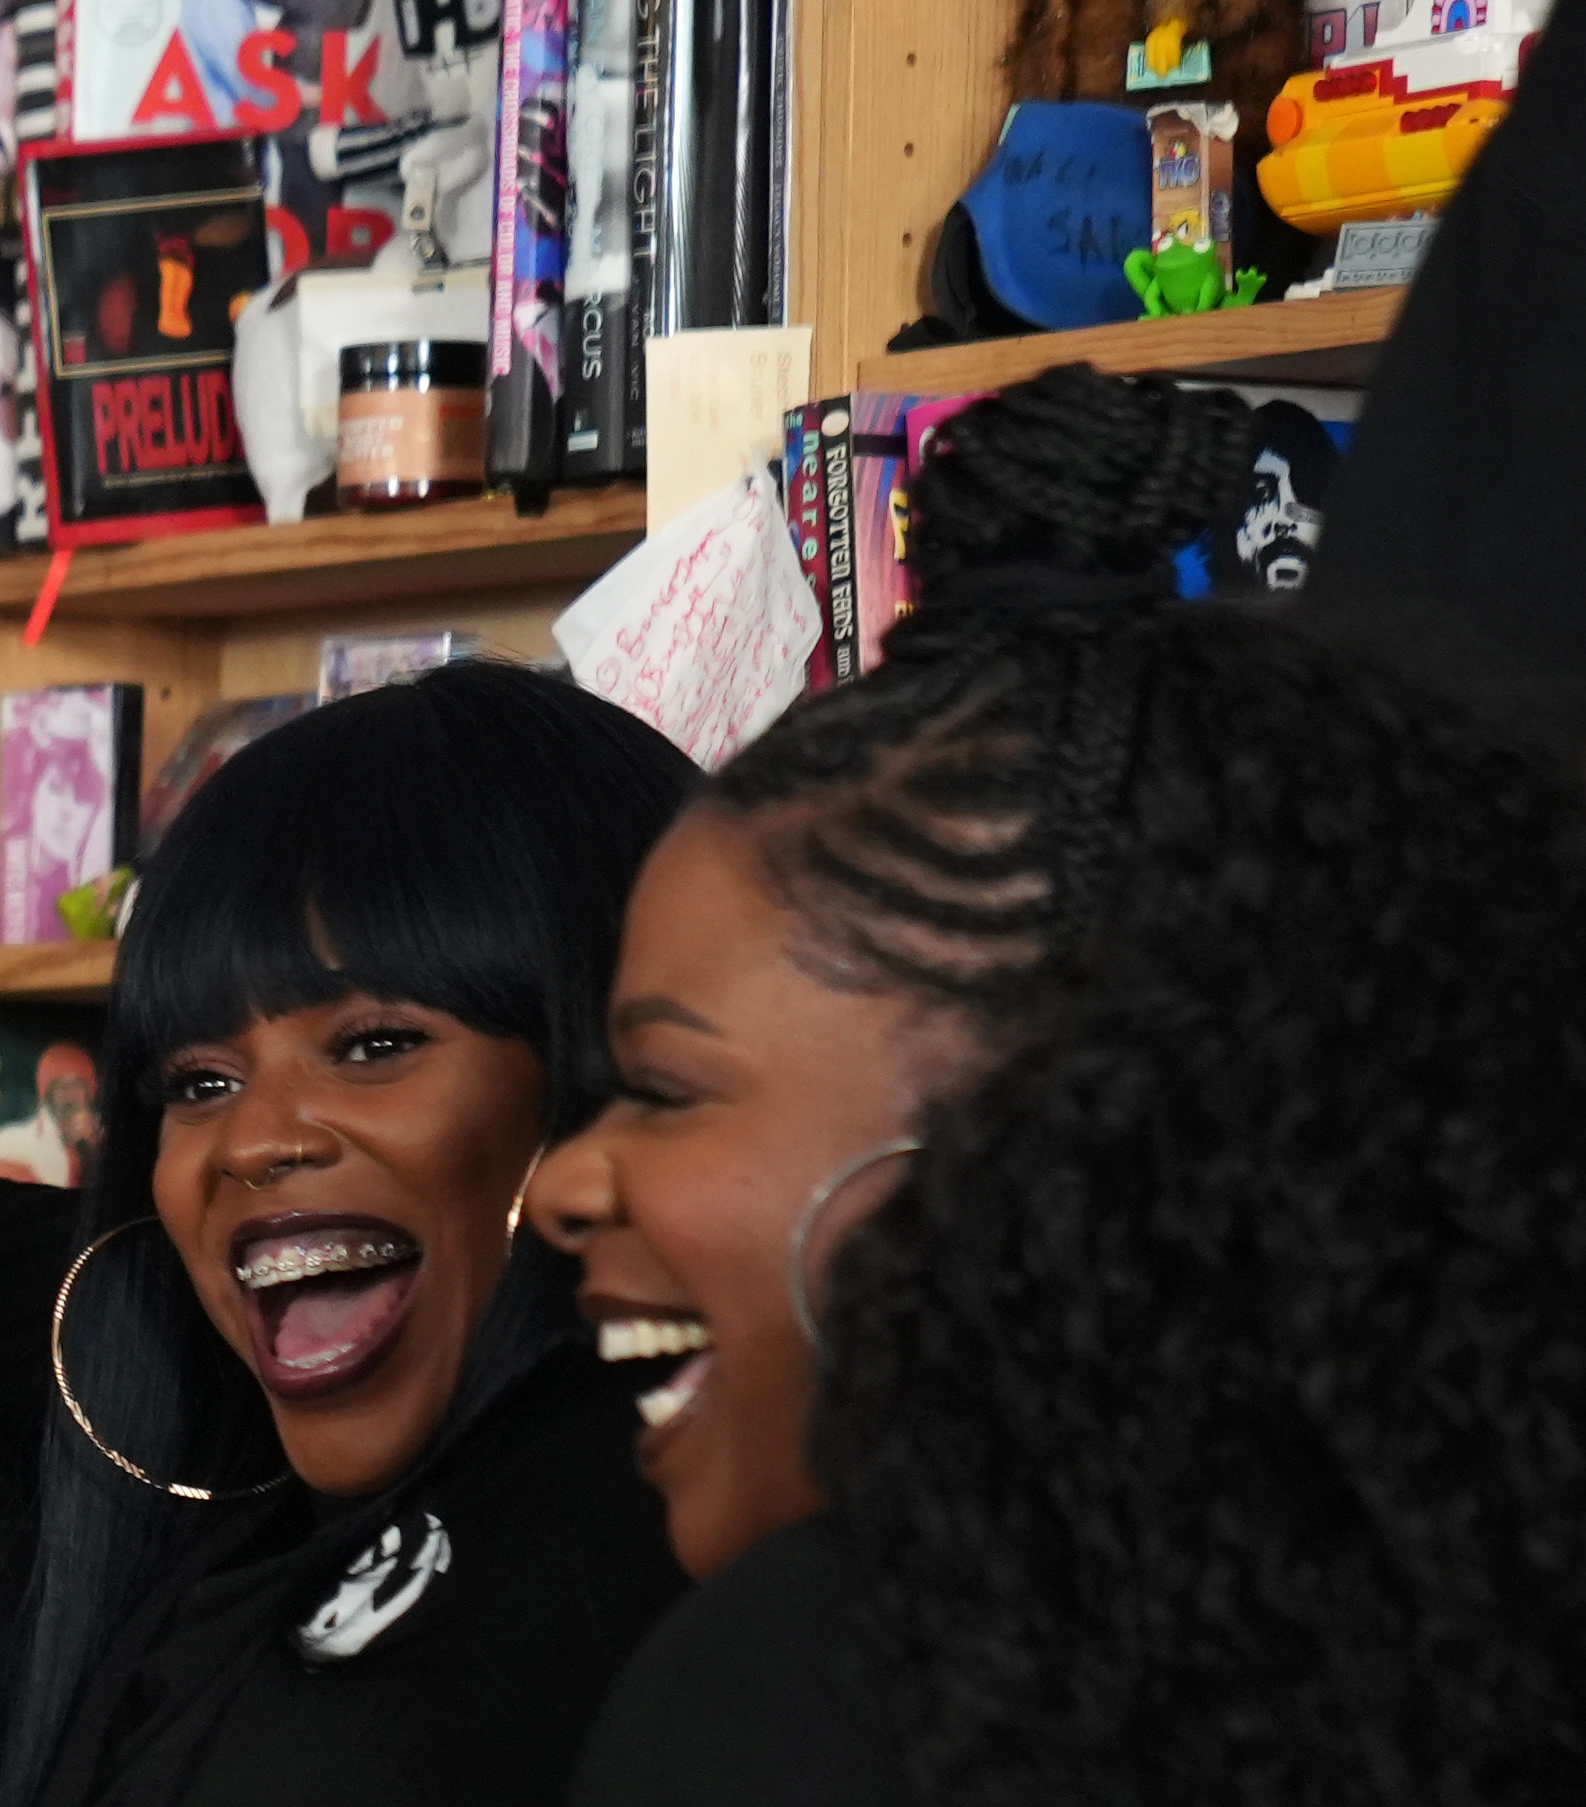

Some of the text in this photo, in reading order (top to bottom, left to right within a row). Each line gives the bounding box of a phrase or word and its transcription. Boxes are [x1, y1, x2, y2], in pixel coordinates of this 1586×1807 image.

[131, 29, 391, 132] ASK
[635, 25, 660, 110] THE
[497, 79, 521, 191] CROSSROADS
[633, 121, 659, 260] LIGHT
[495, 221, 517, 275] COLOR
[493, 279, 516, 316] AND
[491, 318, 515, 376] MUSIC
[825, 441, 852, 580] FORGOTTEN
[831, 581, 854, 641] FADS
